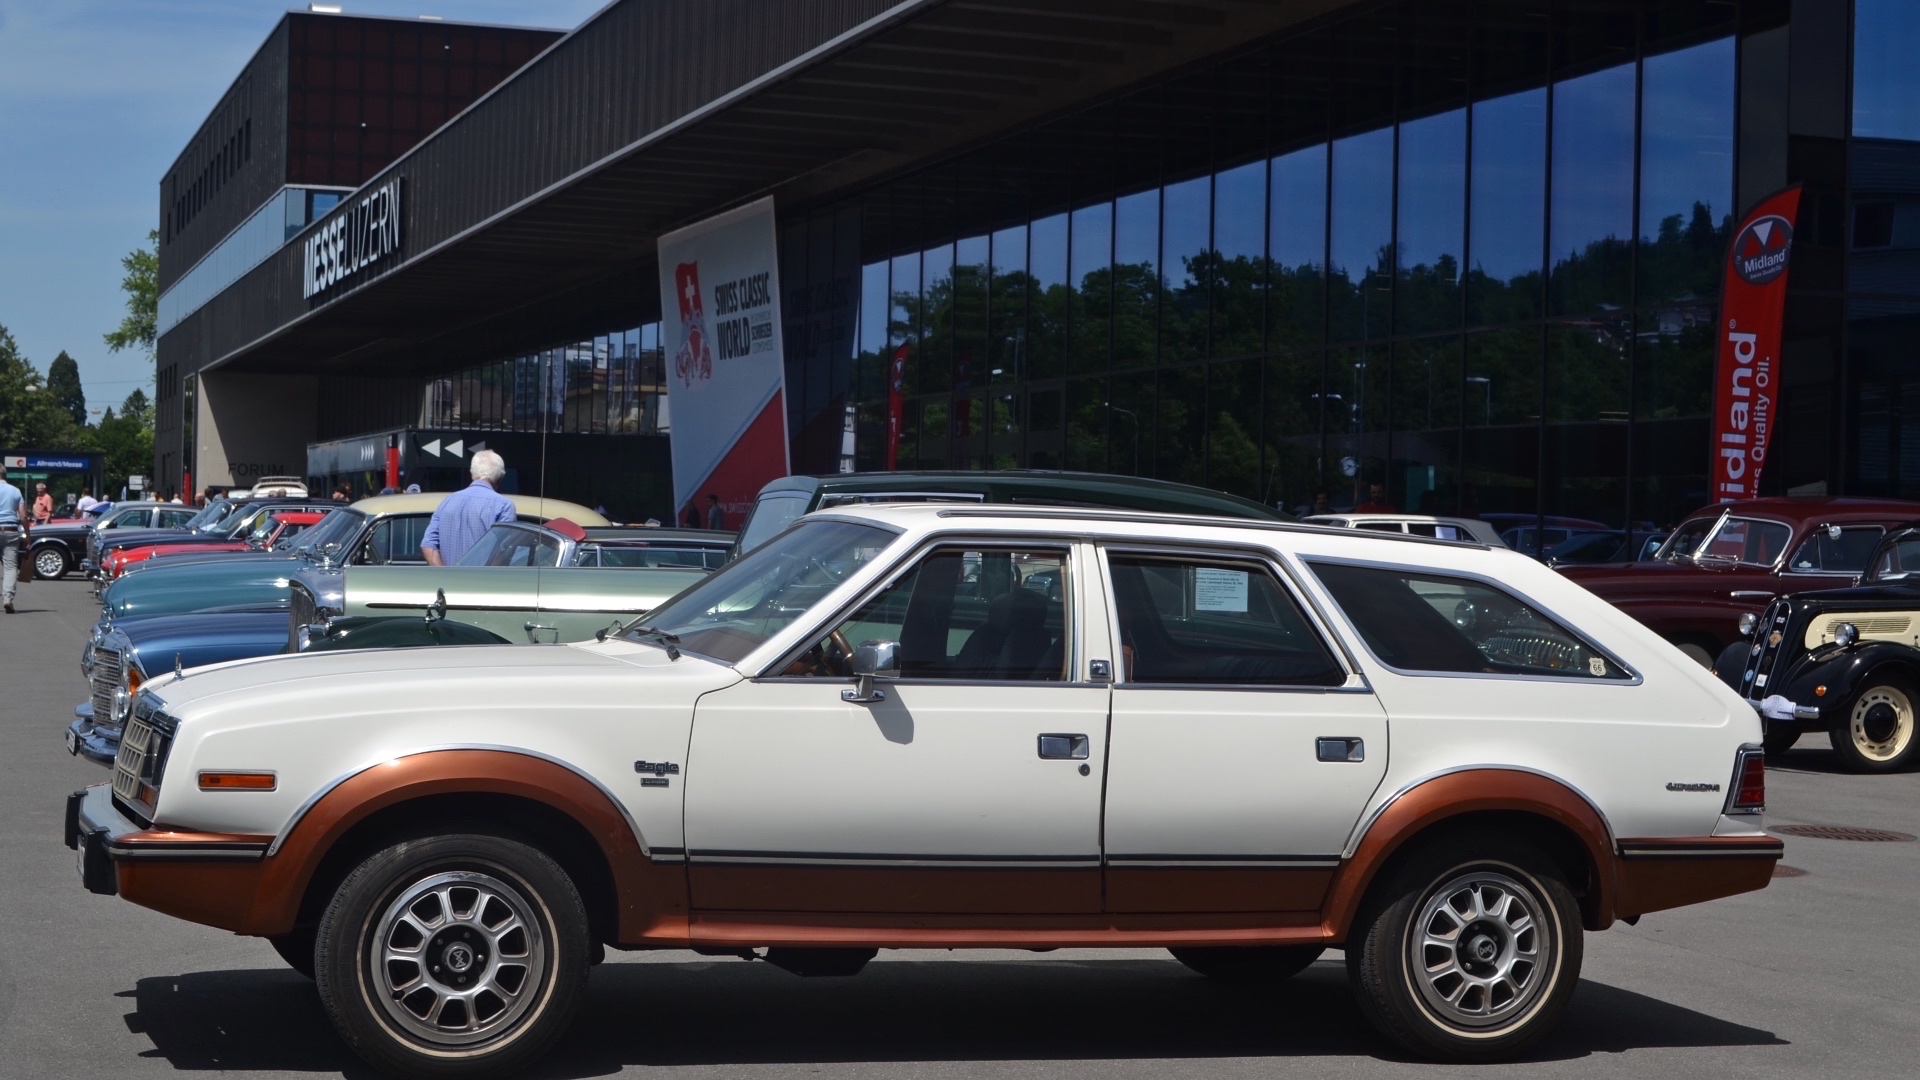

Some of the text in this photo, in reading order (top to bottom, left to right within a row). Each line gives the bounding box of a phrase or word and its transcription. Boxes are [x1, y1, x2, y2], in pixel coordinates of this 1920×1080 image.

[715, 271, 770, 317] SWISS CLASSIC
[717, 316, 750, 360] WORLD
[1755, 356, 1770, 388] Oil.
[1752, 393, 1770, 462] Quality
[228, 463, 284, 476] FORUM
[1593, 663, 1602, 672] 66
[634, 760, 680, 777] Eagle
